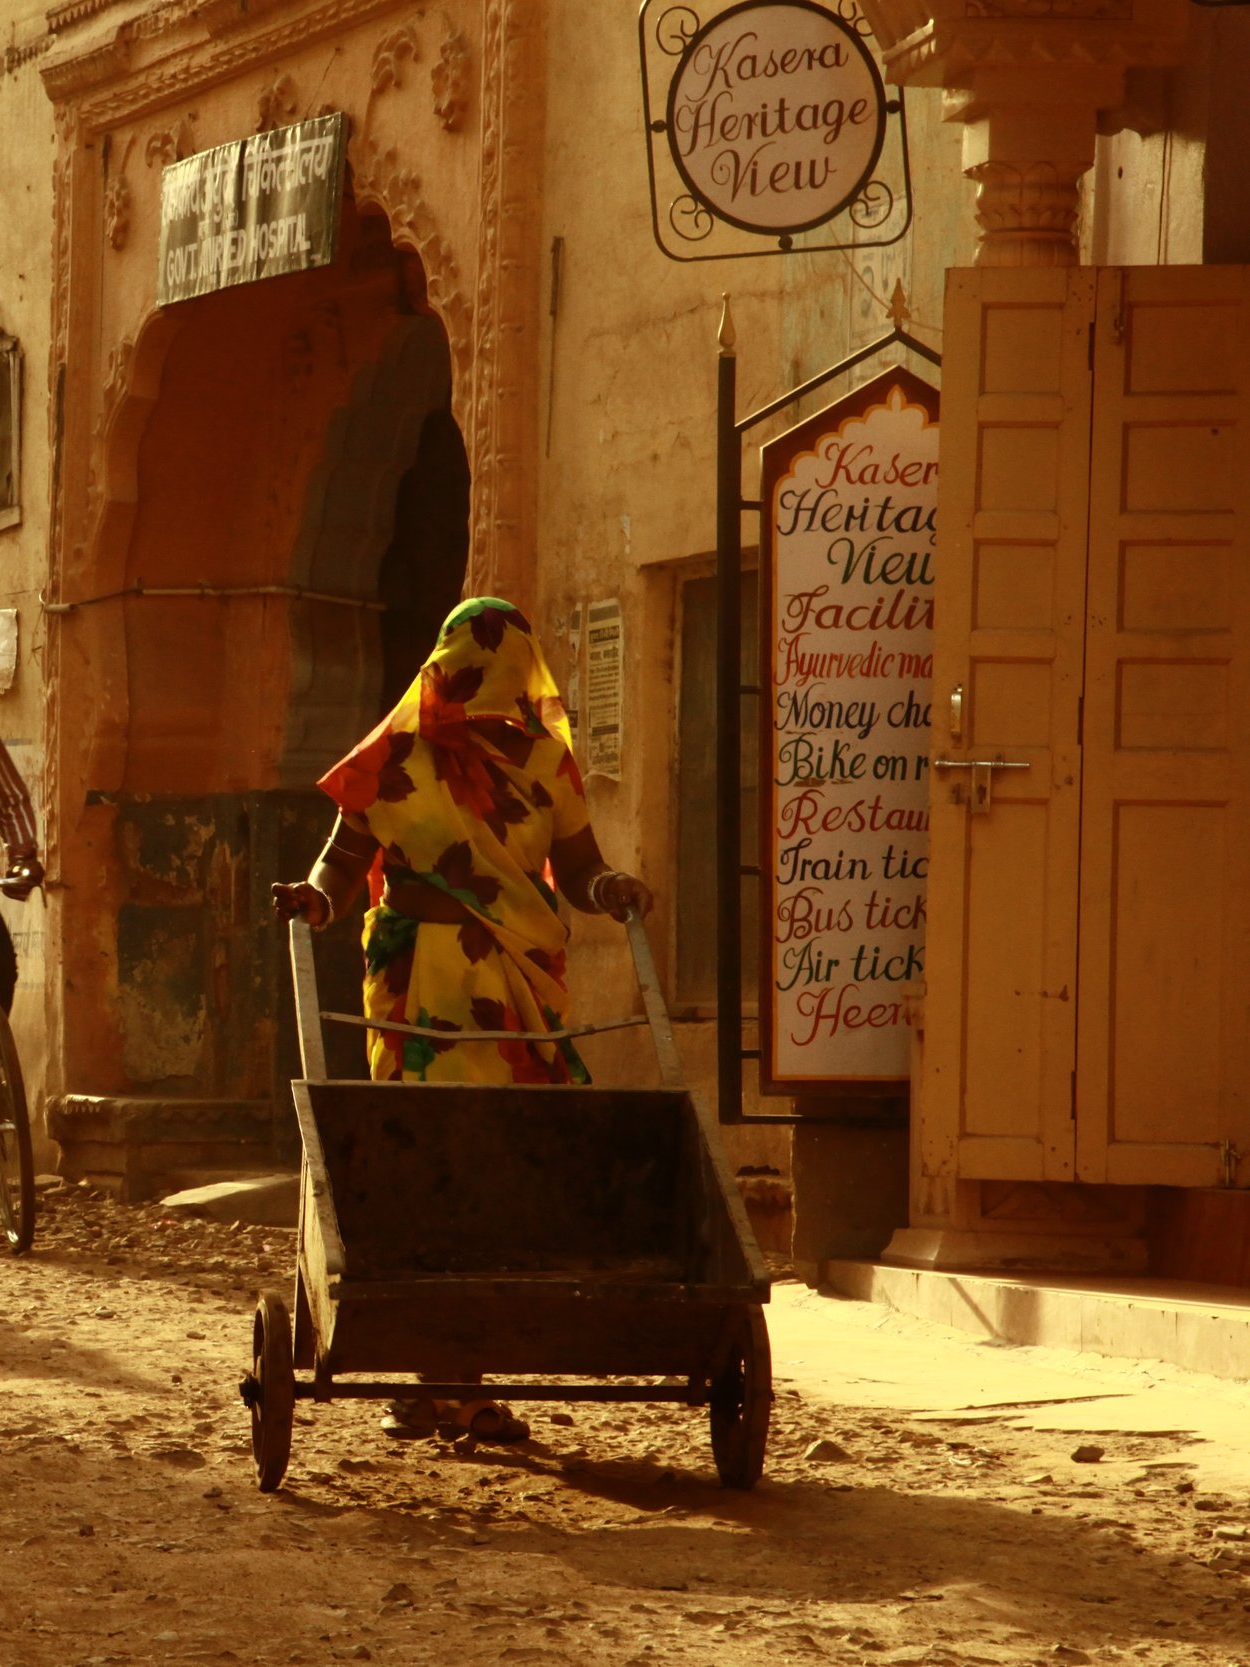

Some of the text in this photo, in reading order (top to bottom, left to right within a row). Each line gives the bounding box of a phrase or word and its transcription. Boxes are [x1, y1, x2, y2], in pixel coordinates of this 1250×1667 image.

[685, 31, 850, 101] Kasera
[676, 90, 870, 158] Heritage
[710, 141, 838, 203] View
[248, 213, 311, 264] HOSPITAL
[773, 632, 896, 687] Ayurvedic
[775, 682, 879, 740] Money
[774, 731, 867, 786] Bike
[872, 754, 907, 781] on
[776, 837, 872, 885] Train
[776, 886, 855, 943] Bus
[776, 936, 840, 991] Air
